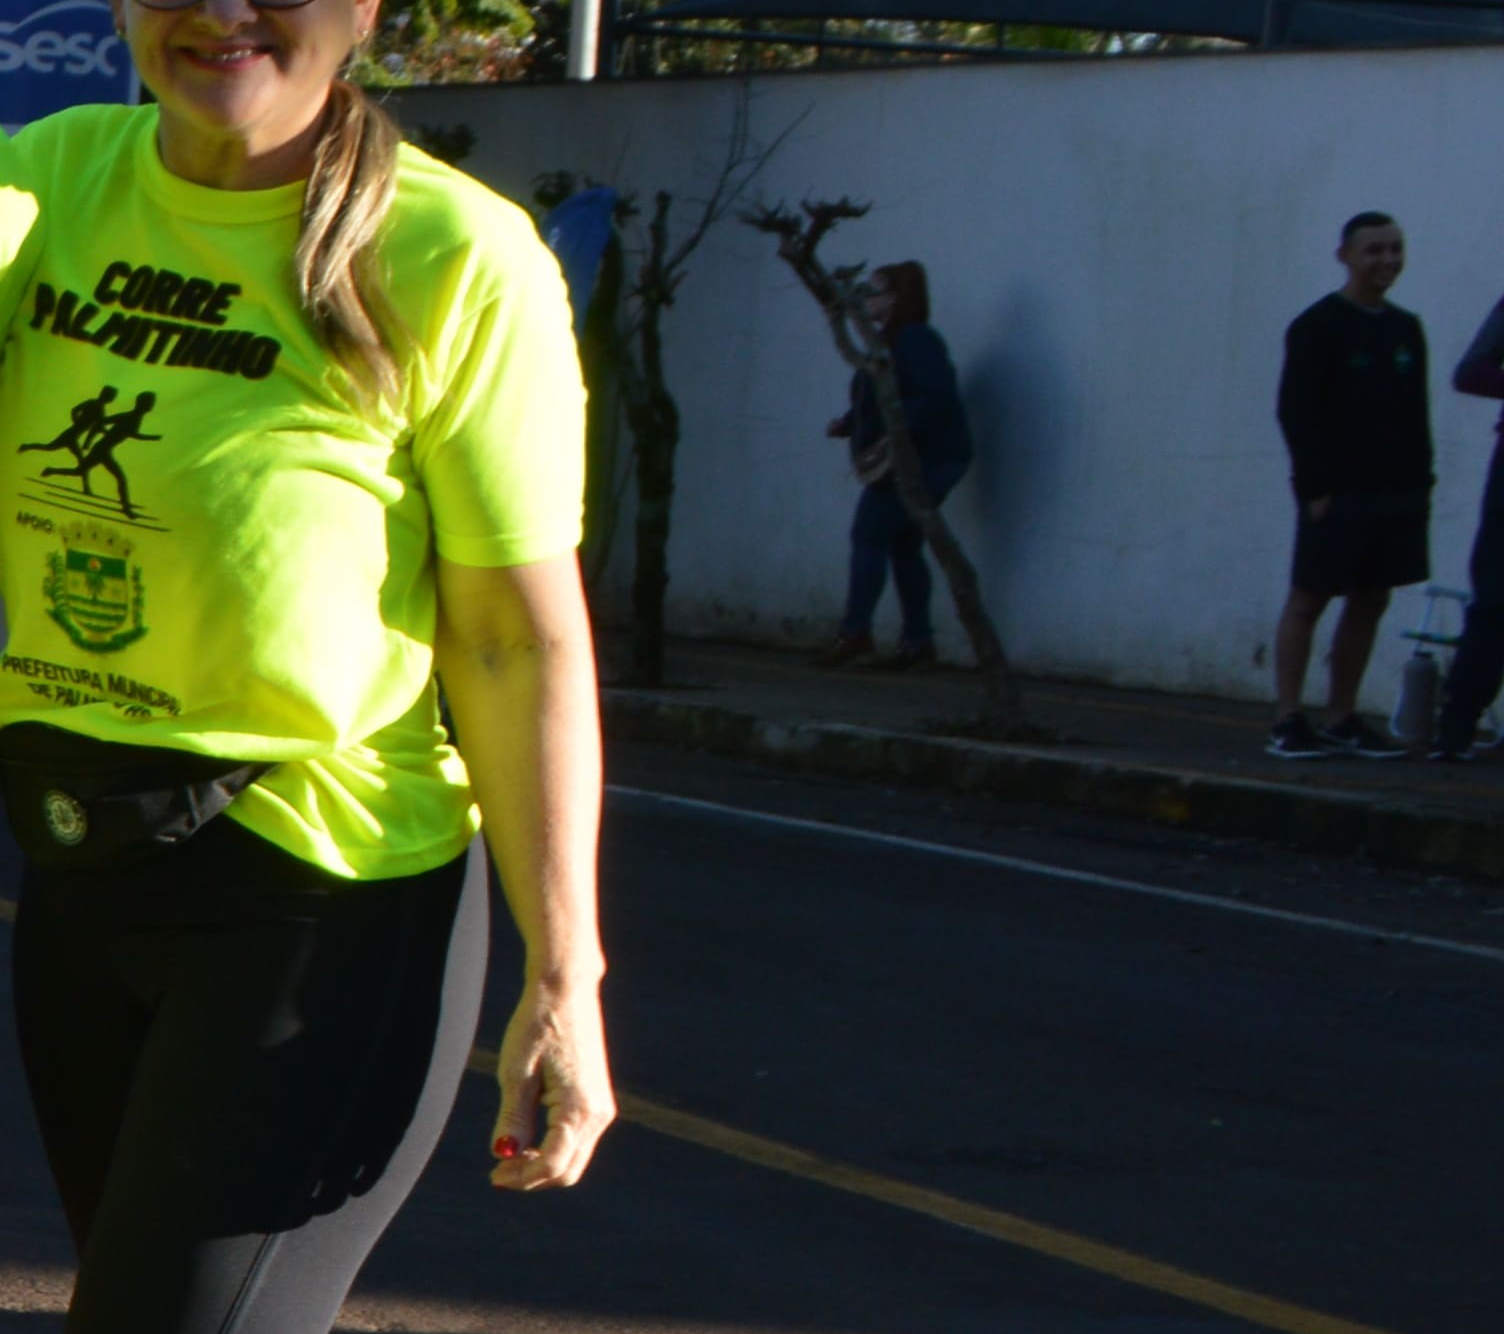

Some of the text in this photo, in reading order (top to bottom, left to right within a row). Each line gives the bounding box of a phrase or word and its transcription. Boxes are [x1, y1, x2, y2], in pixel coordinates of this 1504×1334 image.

[95, 261, 242, 326] CORRE
[30, 282, 283, 380] PALMITINHO
[2, 653, 103, 691] PREFEITURA
